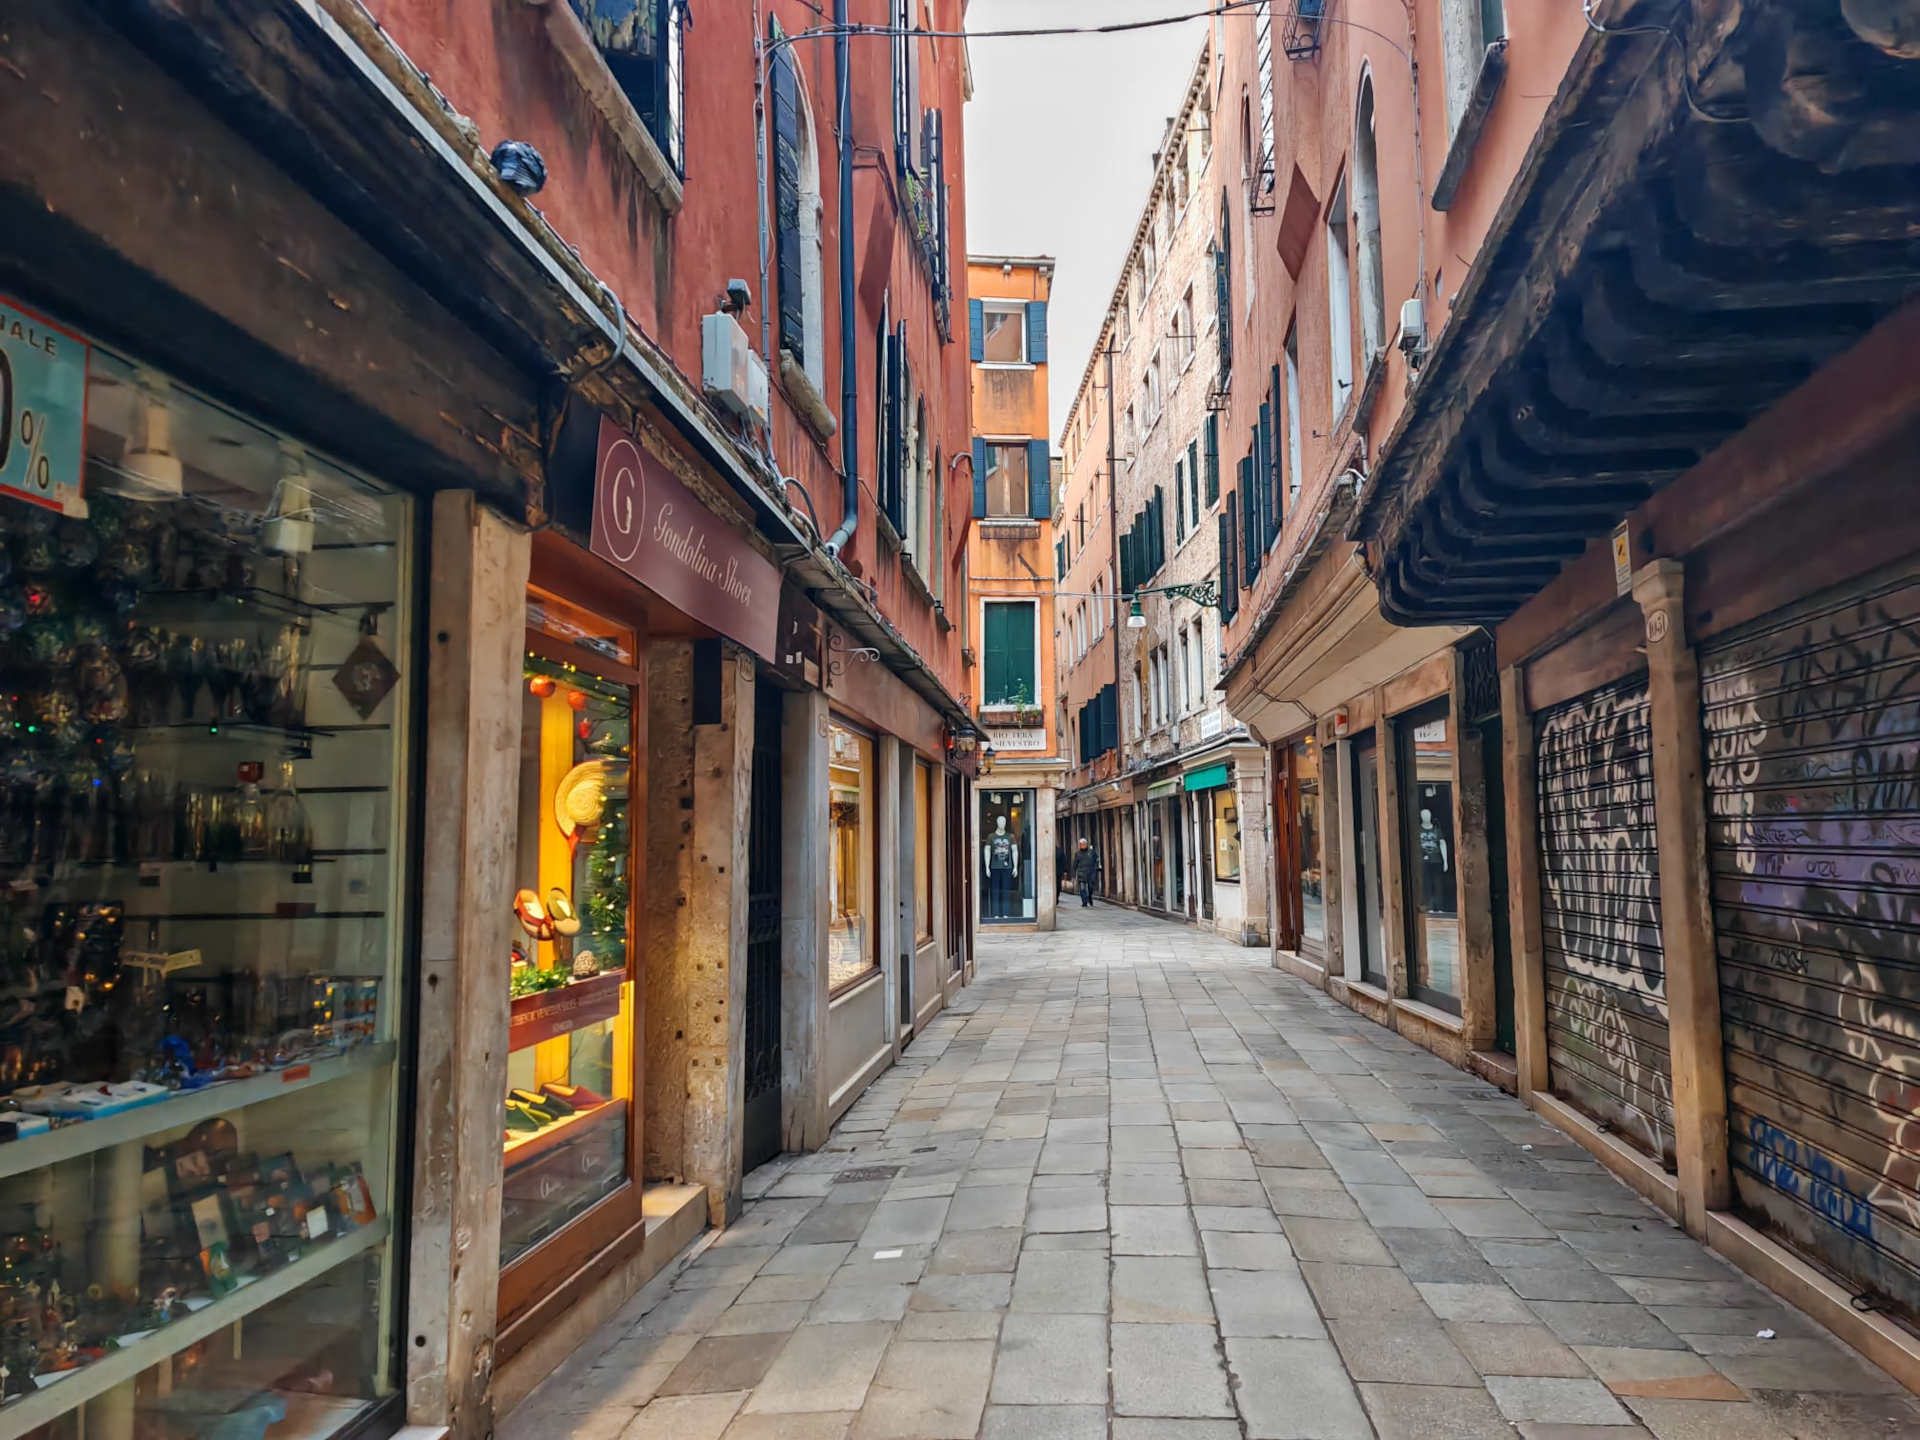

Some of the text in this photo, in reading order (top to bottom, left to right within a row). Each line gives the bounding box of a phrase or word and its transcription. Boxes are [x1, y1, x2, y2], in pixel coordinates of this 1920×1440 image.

[0, 314, 56, 356] ALE
[653, 502, 752, 607] Gondolina Shoes
